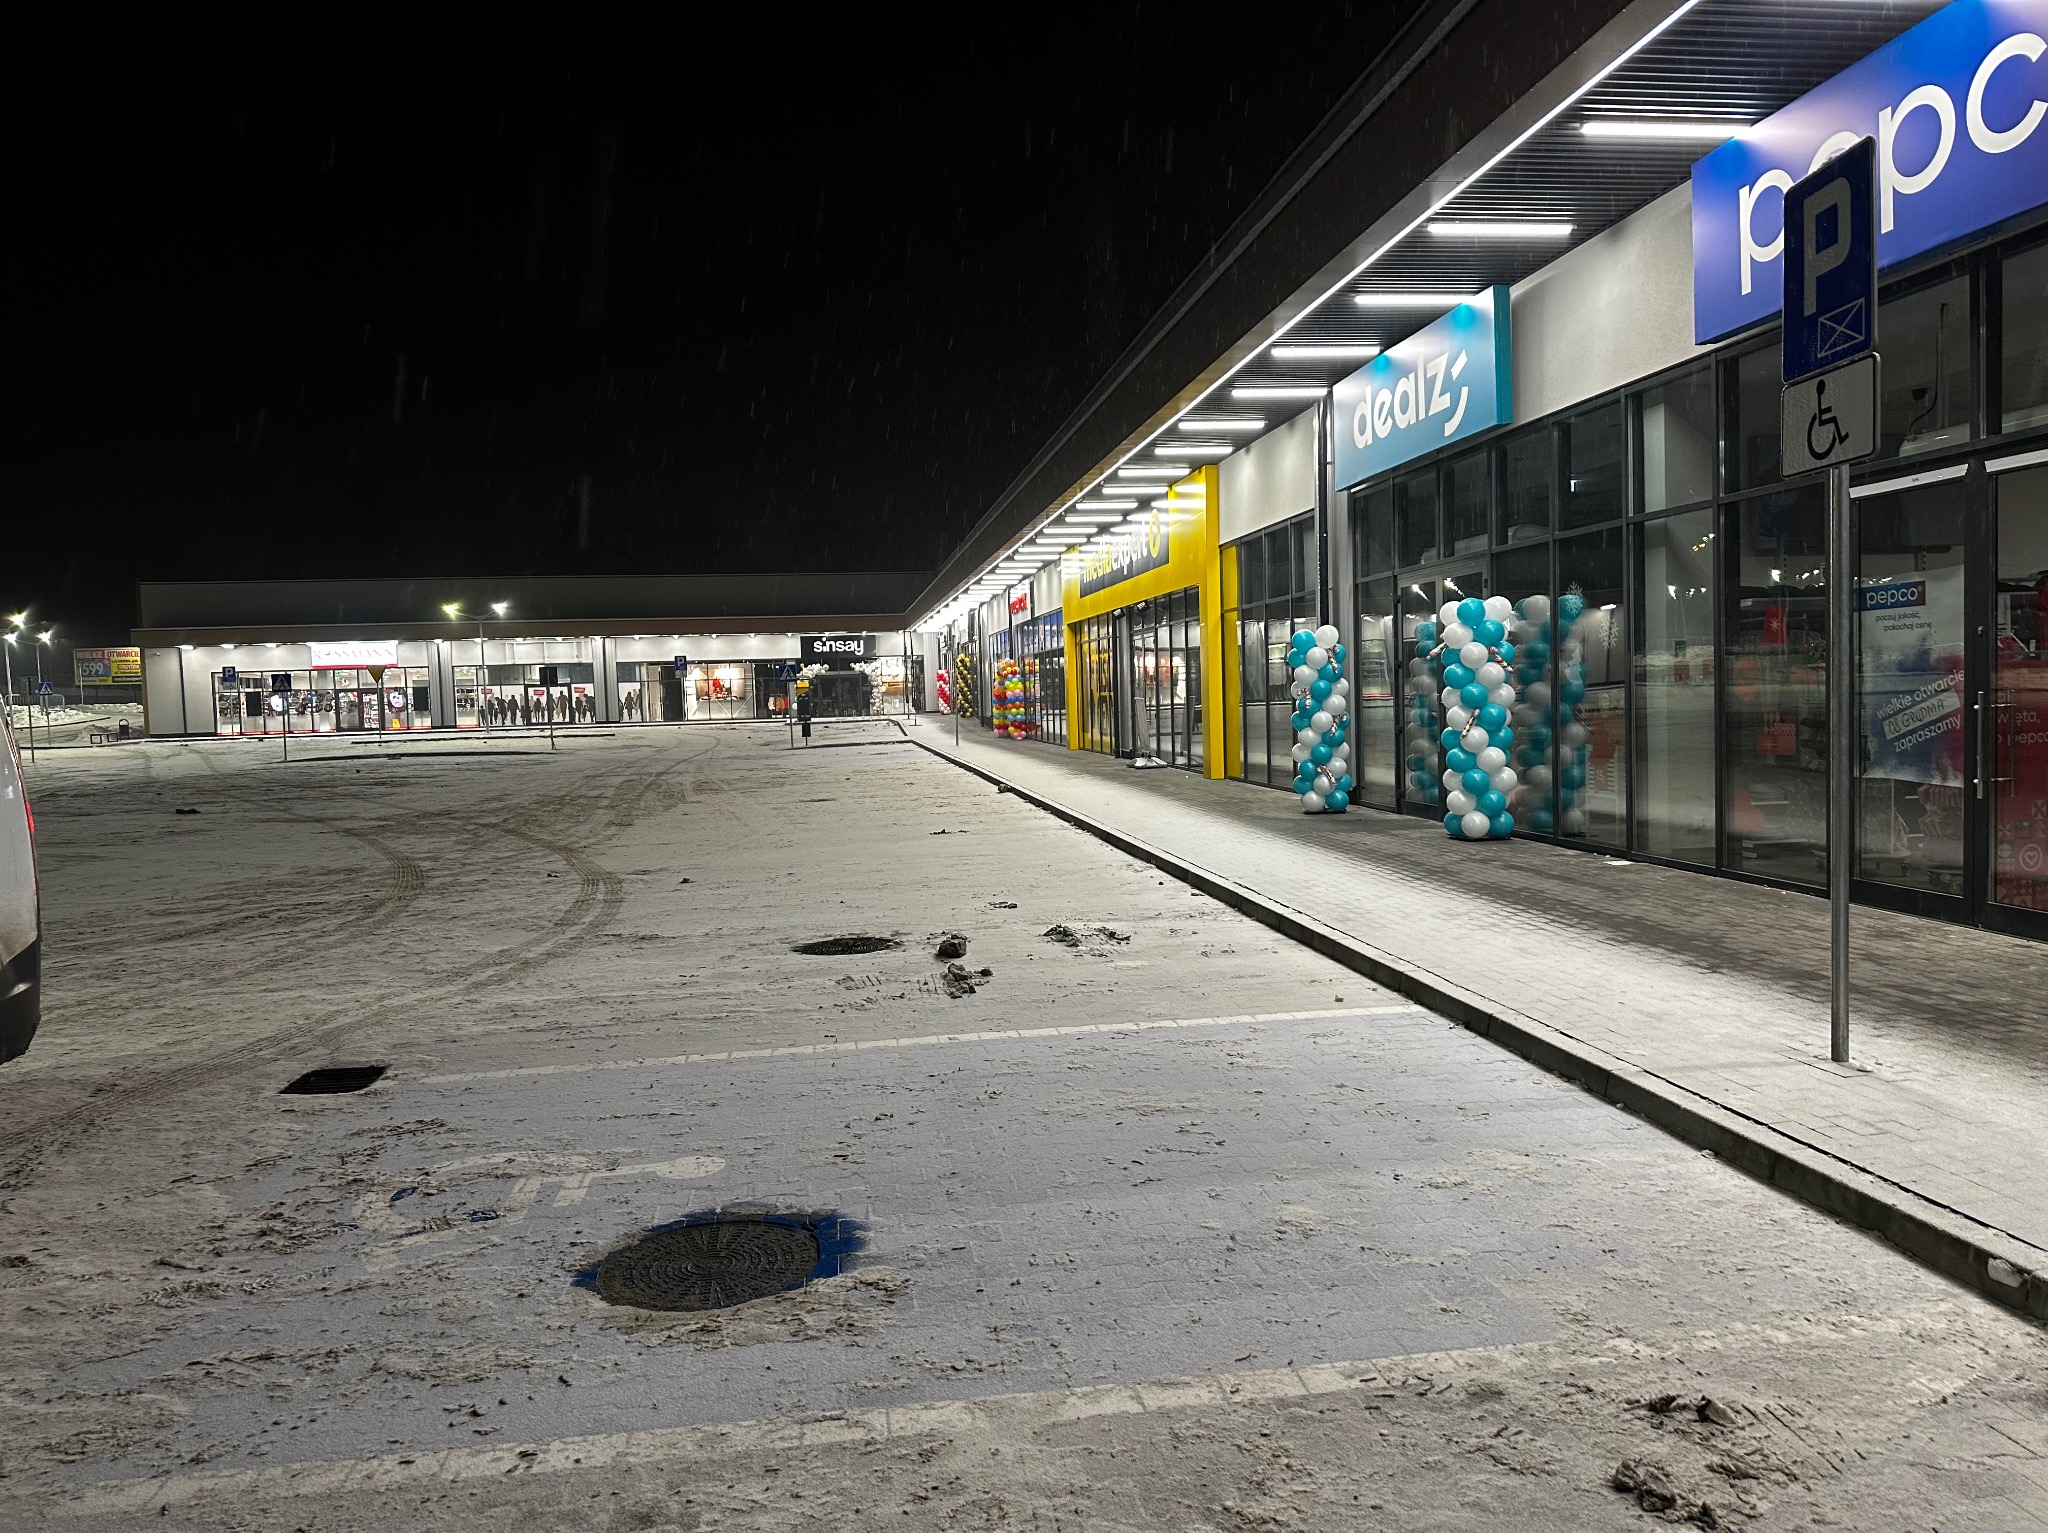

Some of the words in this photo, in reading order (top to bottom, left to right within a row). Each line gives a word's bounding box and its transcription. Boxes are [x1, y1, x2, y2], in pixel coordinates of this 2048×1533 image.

[1803, 176, 1852, 318] P
[1352, 350, 1452, 450] dealz
[1866, 587, 1919, 608] pepco
[813, 637, 864, 655] sinsay
[225, 668, 234, 678] P
[677, 656, 685, 667] P
[1877, 694, 1912, 719] wielkie
[1914, 669, 1965, 701] otwarcie
[1894, 714, 1961, 753] zapraszamy
